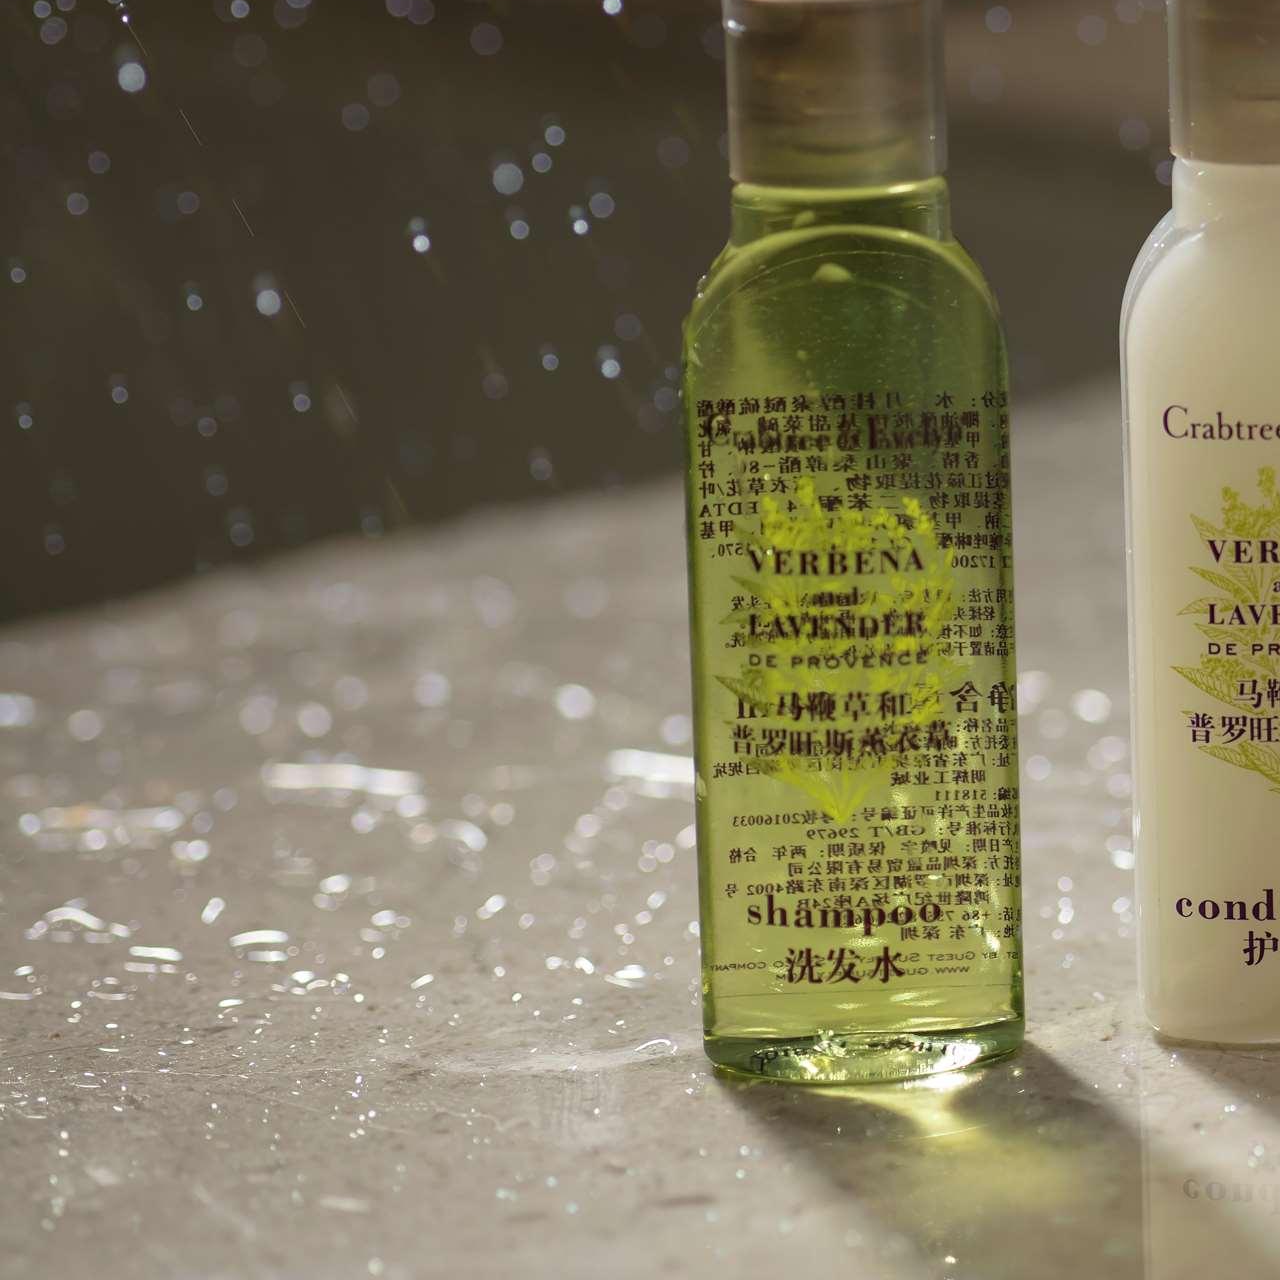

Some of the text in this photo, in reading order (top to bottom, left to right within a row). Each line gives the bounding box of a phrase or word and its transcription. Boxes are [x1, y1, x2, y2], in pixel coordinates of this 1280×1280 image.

[749, 548, 924, 576] VERBENA
[747, 611, 924, 640] LAVENDER
[750, 652, 929, 670] DE PROVENCE
[1208, 642, 1237, 656] DE
[746, 894, 942, 938] shampoo
[785, 947, 906, 984] 洗发水
